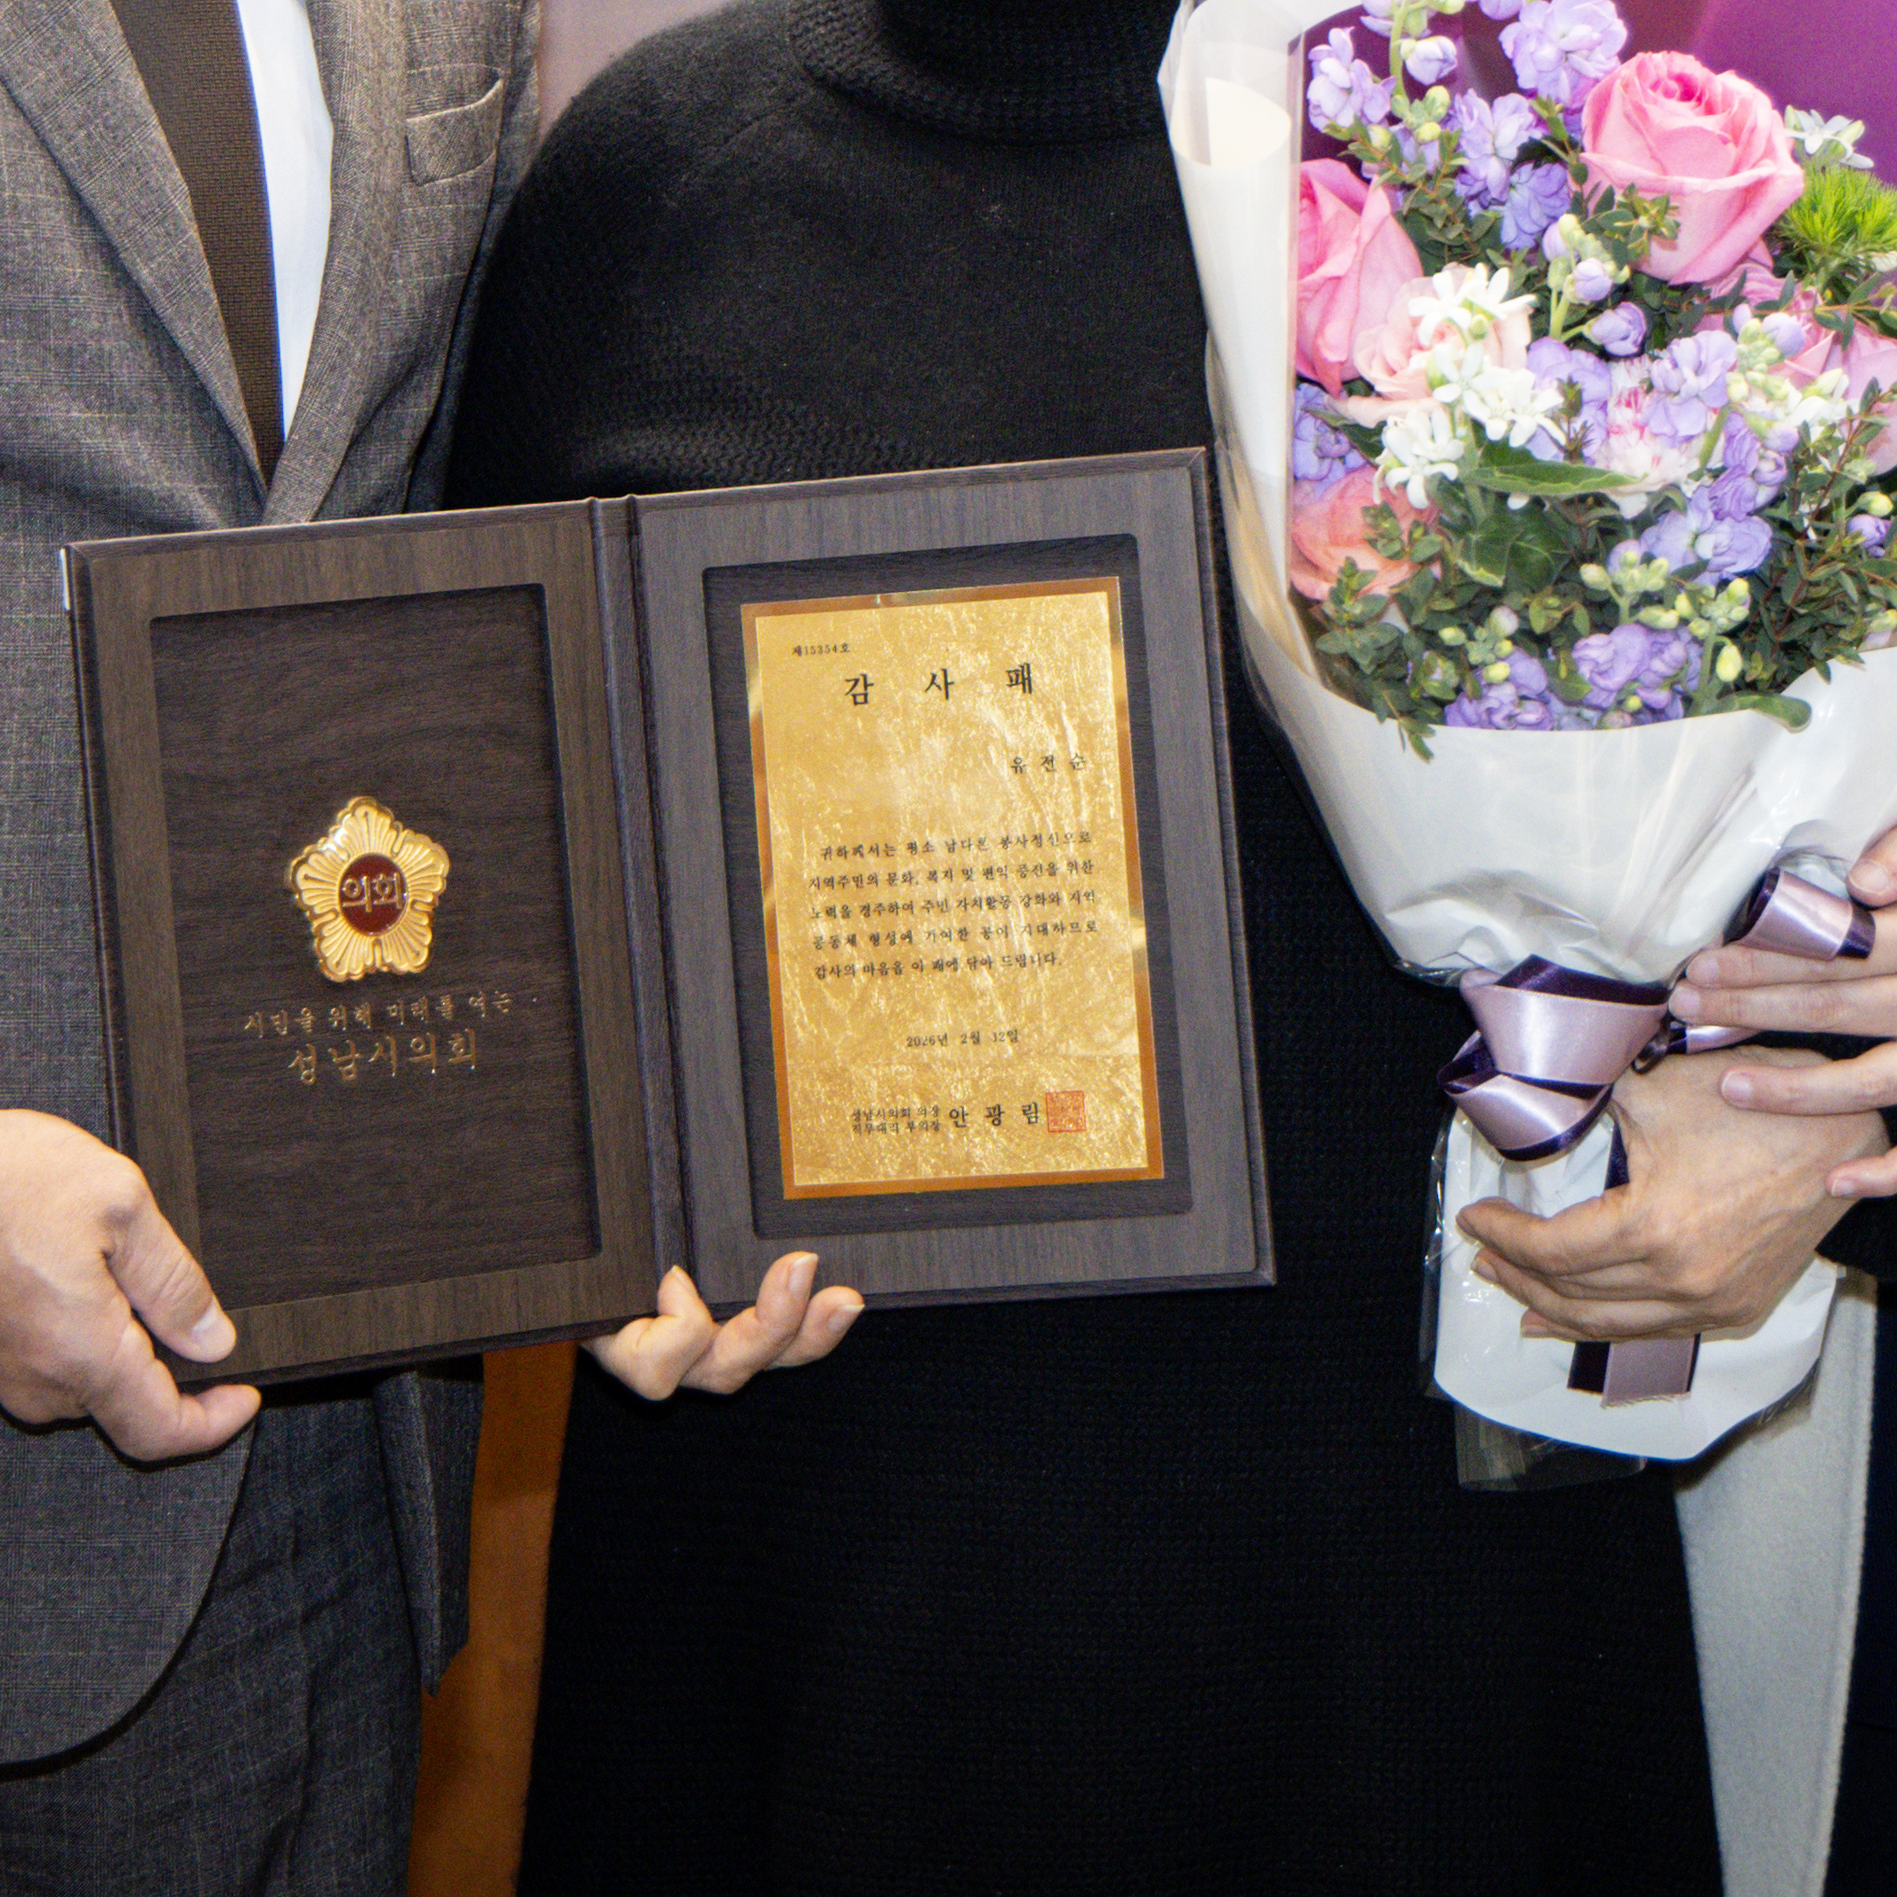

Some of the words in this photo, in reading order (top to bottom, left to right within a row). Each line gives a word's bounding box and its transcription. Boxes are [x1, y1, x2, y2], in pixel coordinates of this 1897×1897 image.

[820, 842, 897, 861] 귀하께서는
[906, 839, 935, 856] 평소
[944, 836, 989, 853] 남다른
[1000, 831, 1092, 850] 봉사정신으로
[809, 872, 880, 891] 지역주민의
[886, 870, 920, 887] 문화,
[926, 866, 954, 883] 복지
[961, 866, 974, 883] 및
[982, 864, 1009, 881] 편익
[1016, 861, 1059, 879] 증진을
[1066, 859, 1095, 876] 위한
[342, 872, 403, 913] 의회
[810, 903, 853, 920] 노력을
[859, 901, 915, 919] 경주하여
[921, 899, 949, 914] 주민
[956, 894, 1011, 912] 자치활동
[1019, 891, 1062, 909] 강화와
[1069, 889, 1097, 905] 지역
[812, 932, 858, 951] 공동체
[869, 930, 914, 947] 형성에
[925, 926, 970, 944] 기여한
[980, 924, 1009, 941] 공이
[1020, 920, 1098, 937] 지대하므로
[815, 963, 856, 981] 감사의
[863, 960, 904, 978] 마음을
[911, 957, 925, 974] 이
[932, 955, 959, 973] 패에
[966, 954, 994, 971] 담아
[1001, 951, 1063, 968] 드립니다.
[244, 1007, 315, 1039] 시민을
[387, 994, 455, 1026] 미래를
[468, 990, 513, 1018] 여는
[906, 1032, 949, 1048] 2026년
[960, 1030, 981, 1045] 2월
[992, 1028, 1020, 1043] 12일
[287, 1027, 477, 1086] 성남시의회
[852, 1106, 912, 1123] 성남시의회
